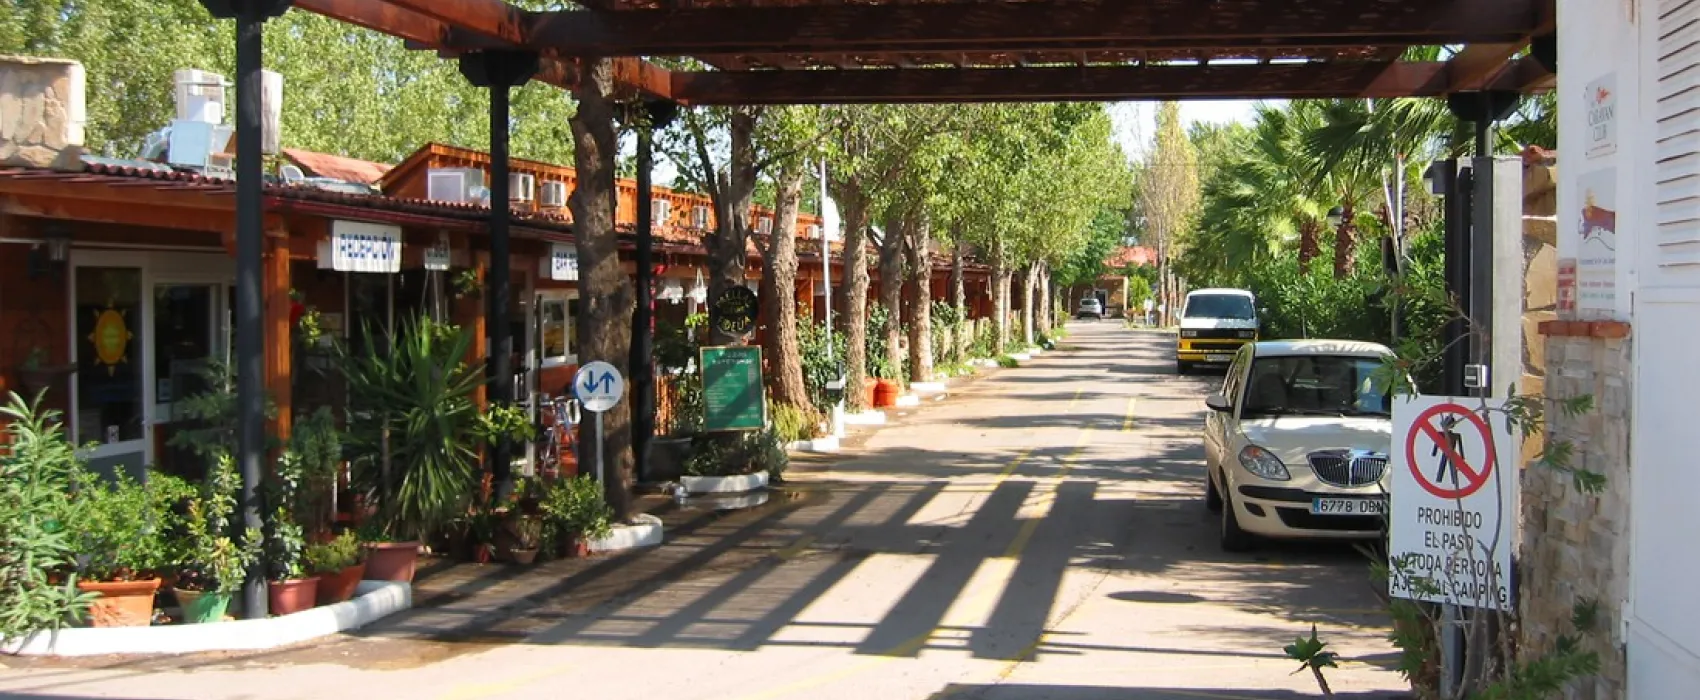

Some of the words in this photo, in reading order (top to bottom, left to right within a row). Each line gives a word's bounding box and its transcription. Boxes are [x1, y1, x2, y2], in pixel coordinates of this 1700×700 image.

[1320, 500, 1353, 513] 6778
[1417, 506, 1482, 529] PROHIBIDO
[1424, 531, 1440, 548] EL
[1442, 532, 1474, 551] PASO
[1446, 556, 1502, 579] PERSOA
[1453, 580, 1508, 603] CAMPNG
